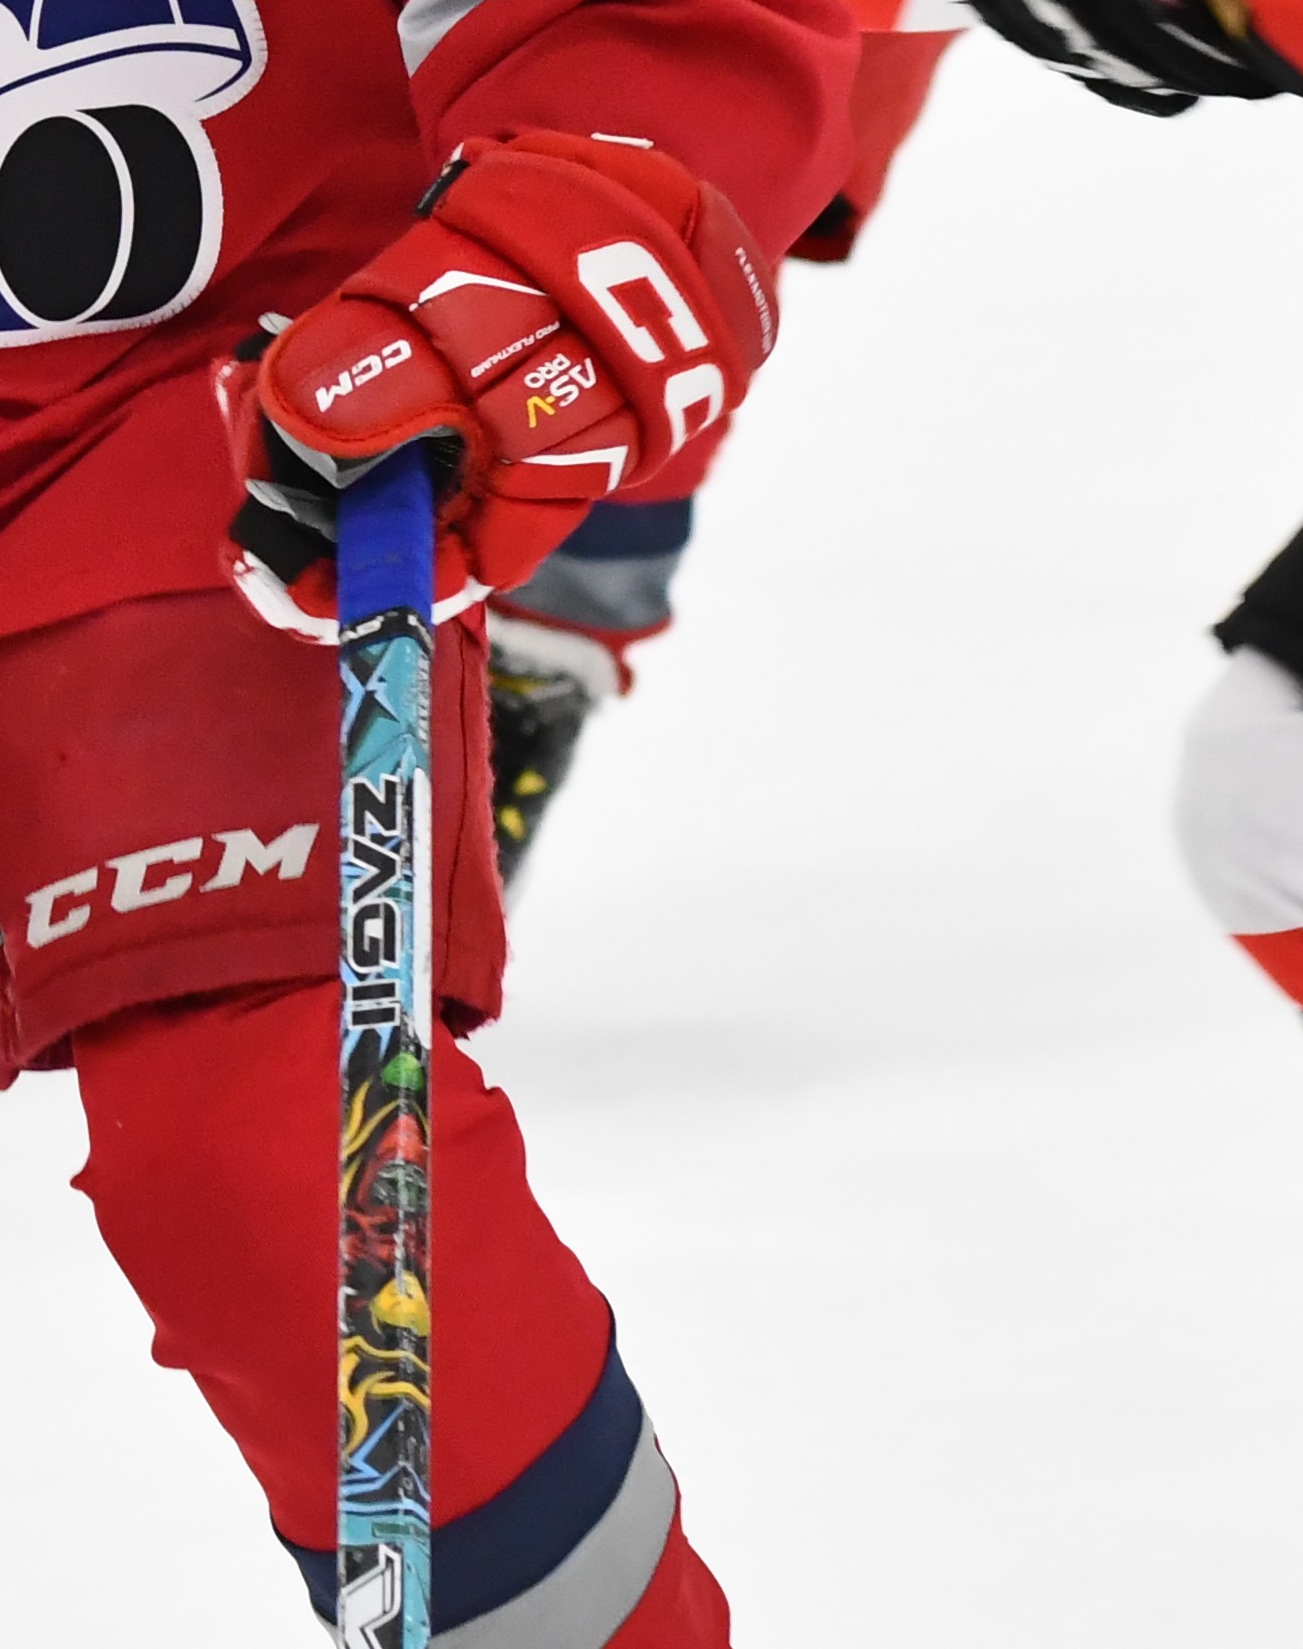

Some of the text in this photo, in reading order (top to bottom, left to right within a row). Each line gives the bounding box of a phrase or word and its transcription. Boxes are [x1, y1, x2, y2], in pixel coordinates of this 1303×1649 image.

[314, 338, 413, 414] CCM
[523, 352, 572, 389] PRO
[24, 822, 320, 951] CCM
